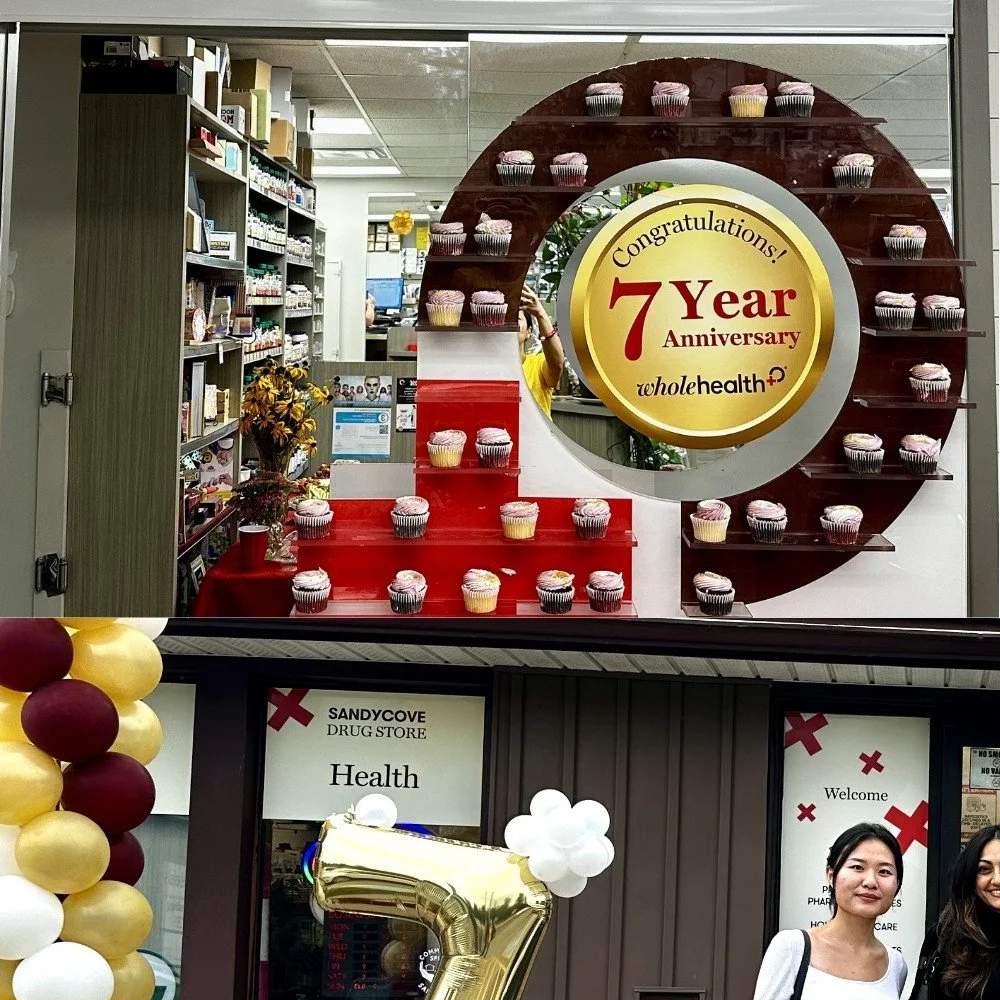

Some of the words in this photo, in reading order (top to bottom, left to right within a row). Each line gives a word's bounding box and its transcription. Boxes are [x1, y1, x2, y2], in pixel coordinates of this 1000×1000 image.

[612, 210, 788, 268] Congratulations!
[609, 277, 662, 361] 7
[669, 279, 797, 320] Year
[662, 327, 801, 350] Anniversary
[637, 373, 765, 397] wholehealth
[328, 707, 426, 723] SANDYCOVE
[326, 723, 373, 738] DRUG
[375, 726, 427, 740] STORE
[978, 750, 987, 758] NO
[329, 763, 420, 789] Health
[981, 767, 990, 775] NO
[824, 786, 889, 802] Welcome
[874, 923, 898, 931] CARE
